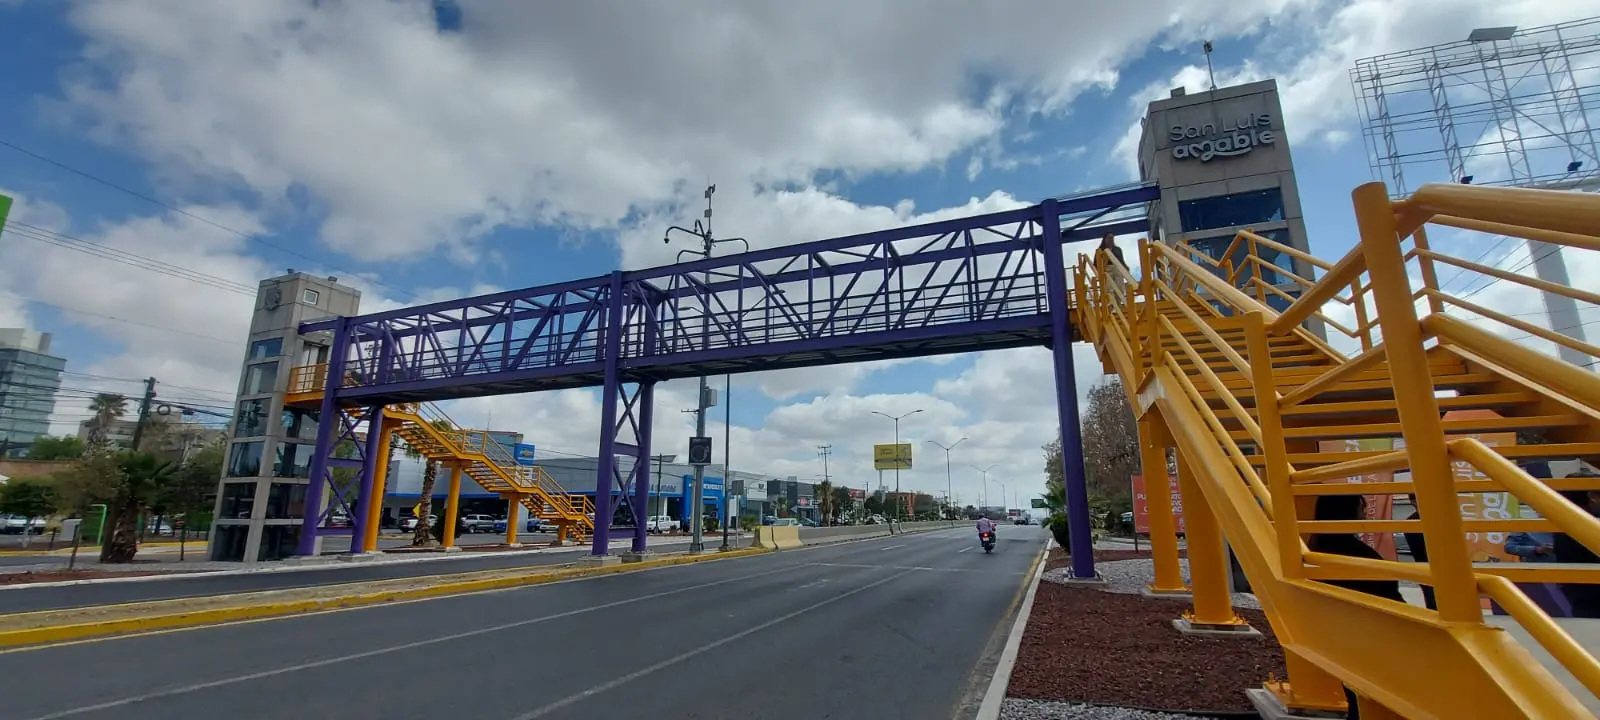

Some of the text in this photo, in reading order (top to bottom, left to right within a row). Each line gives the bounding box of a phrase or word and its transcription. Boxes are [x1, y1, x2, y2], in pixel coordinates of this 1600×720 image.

[1170, 113, 1271, 141] San Luis
[1173, 130, 1275, 162] amable
